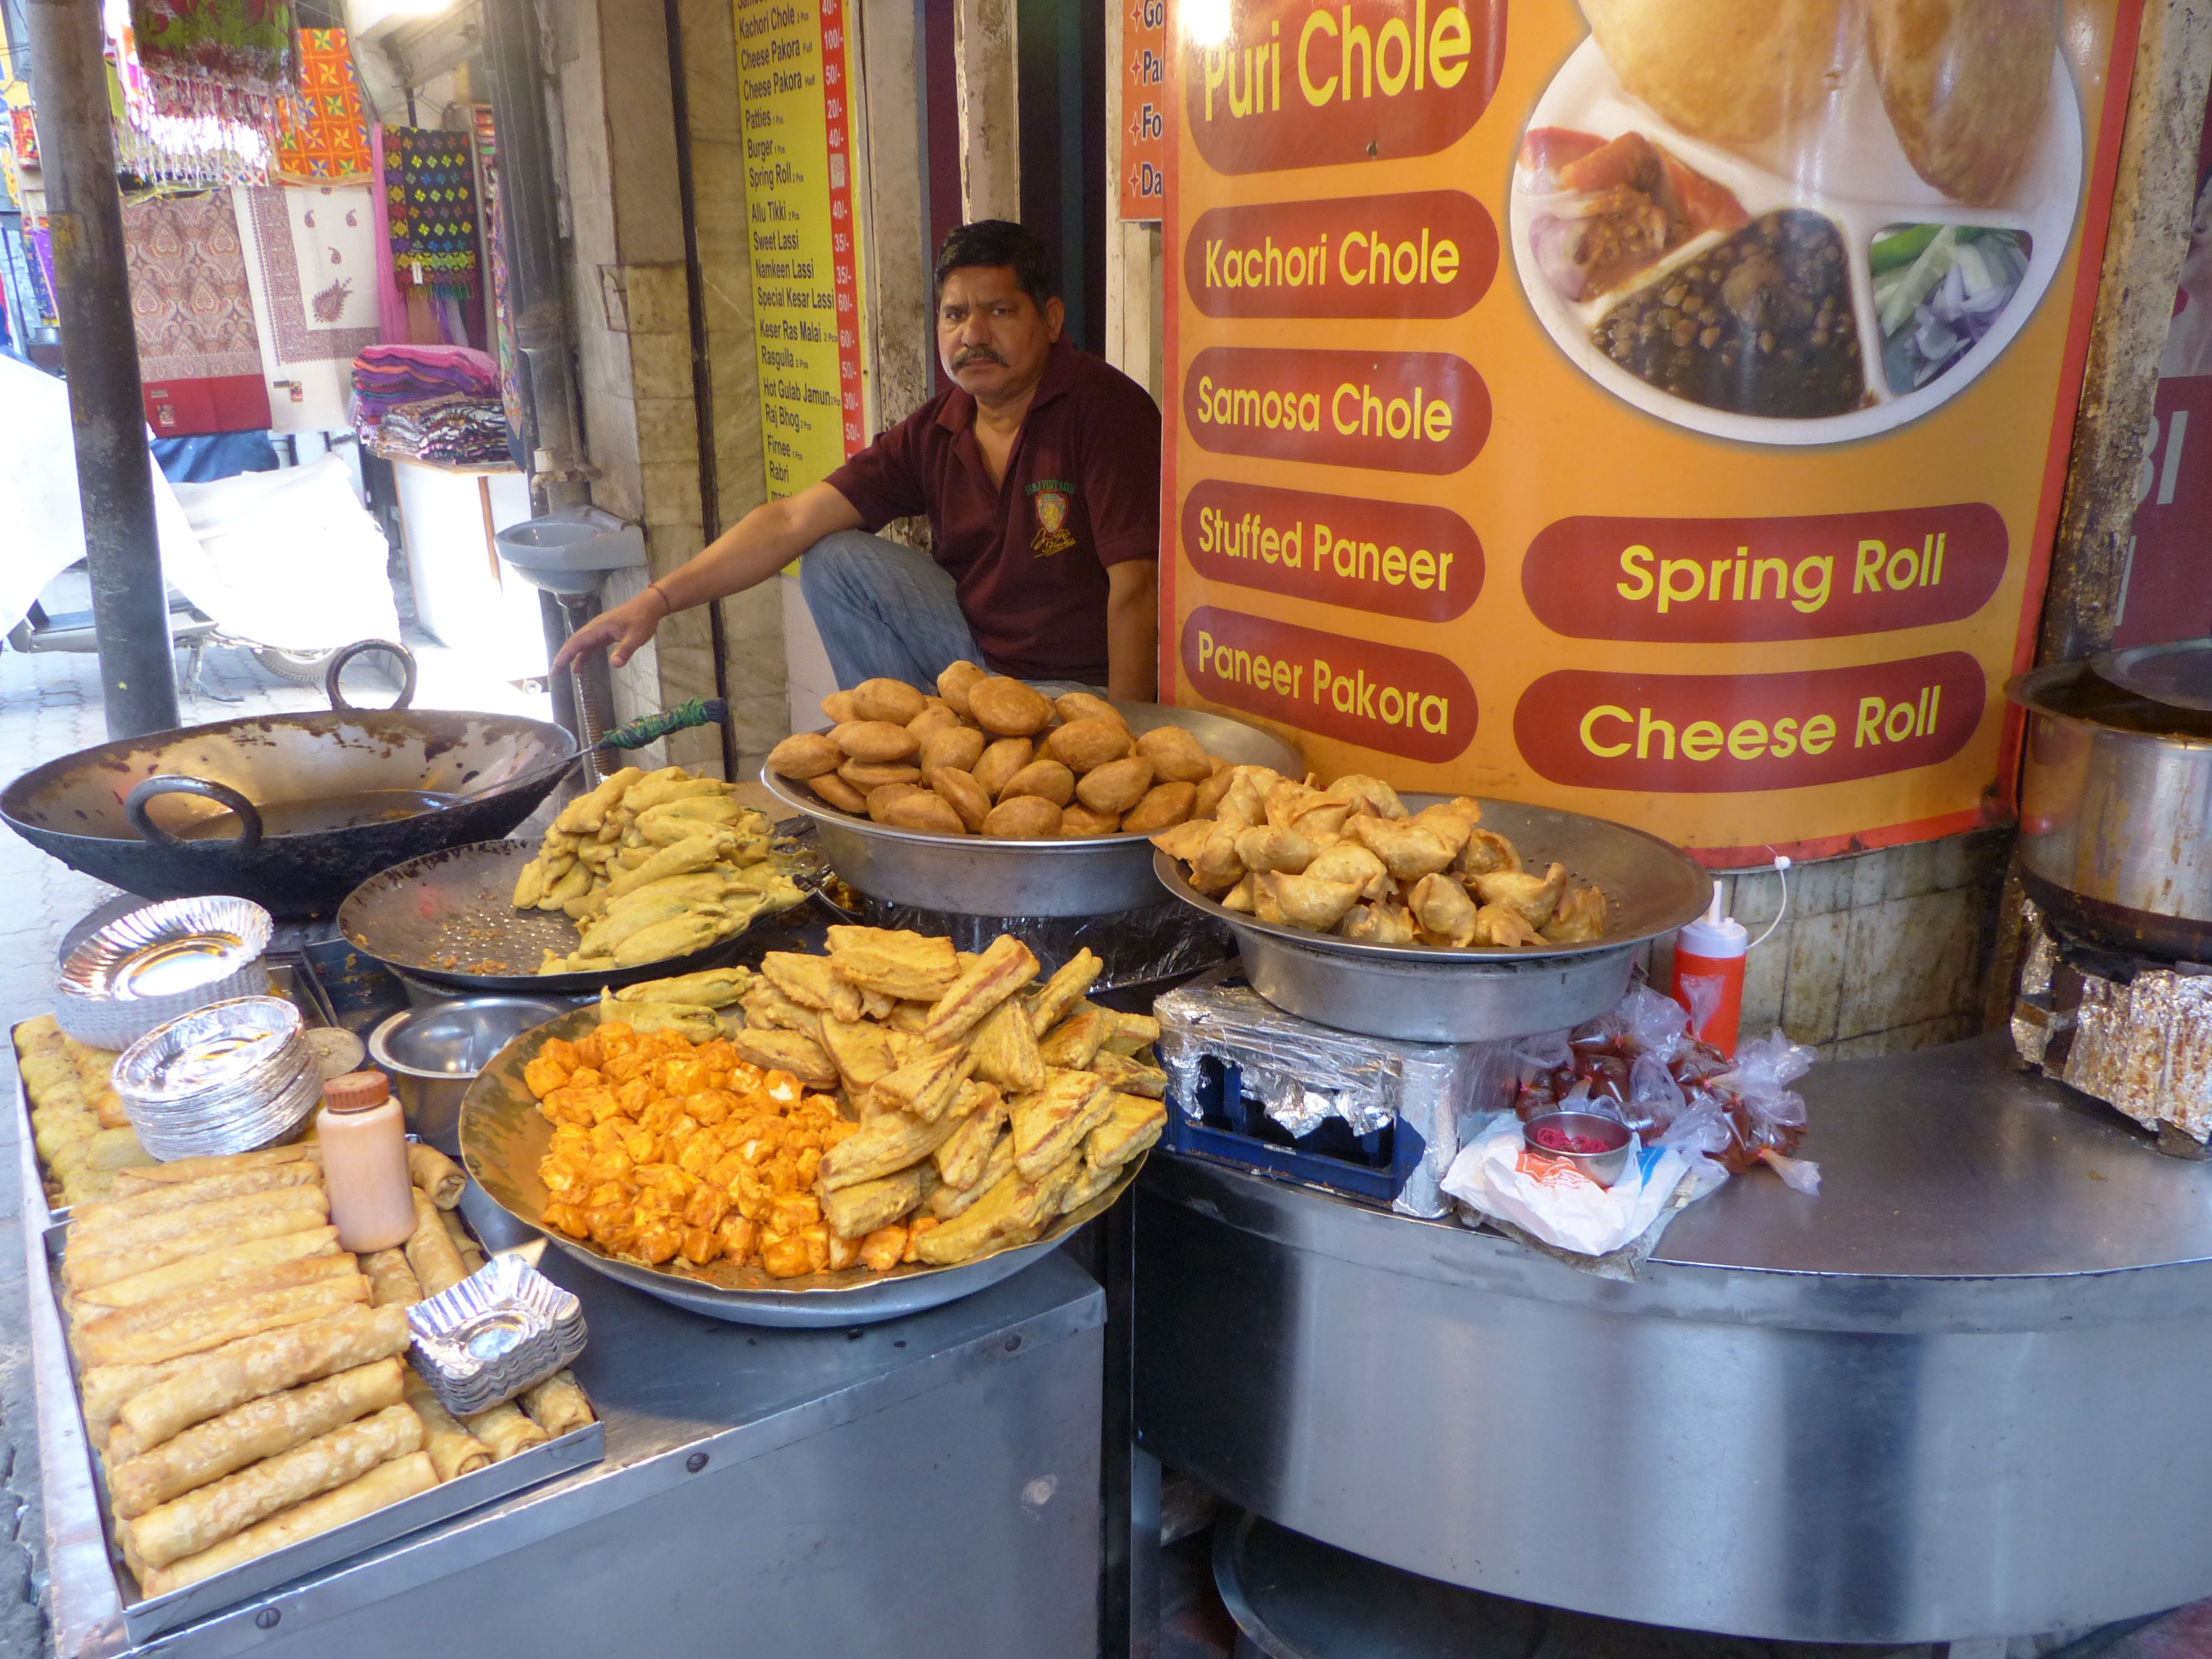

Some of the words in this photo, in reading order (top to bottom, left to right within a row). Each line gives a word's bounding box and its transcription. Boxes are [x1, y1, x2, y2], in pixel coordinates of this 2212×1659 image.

[739, 11, 769, 40] Kachori
[771, 3, 795, 30] Chole
[822, 0, 837, 15] 40/-
[742, 48, 769, 70] Cheese
[771, 38, 800, 63] Pakora
[804, 42, 812, 54] Full
[824, 28, 843, 50] 100/-
[1205, 19, 1280, 122] Puri
[1298, 0, 1471, 107] Chole
[743, 79, 771, 102] Cheese
[774, 70, 802, 95] Pakora
[805, 75, 815, 87] Half
[826, 64, 841, 85] 50/-
[1144, 51, 1162, 84] Pa
[745, 107, 771, 130] Patties
[828, 97, 842, 119] 20/-
[748, 139, 773, 162] Burger
[829, 128, 844, 148] 40/-
[749, 166, 774, 192] Spring
[775, 162, 791, 184] Roll
[752, 203, 766, 223] Allu
[768, 200, 786, 221] Tikki
[833, 200, 847, 220] 40/-
[754, 231, 776, 251] Sweet
[778, 229, 799, 250] Lassi
[834, 233, 849, 252] 35/-
[1206, 233, 1327, 288] Kachori
[1339, 227, 1459, 285] Chole
[755, 259, 790, 279] Namkeen
[792, 258, 814, 279] Lassi
[837, 266, 851, 284] 35/-
[758, 286, 785, 311] Special
[786, 287, 810, 308] Kesar
[812, 288, 834, 310] Lassi
[838, 294, 853, 312] 60/-
[759, 319, 781, 340] Keser
[782, 320, 798, 341] Ras
[800, 321, 821, 343] Malai
[841, 330, 855, 348] 60/-
[761, 346, 794, 372] Rasgulla
[842, 361, 857, 380] 50/-
[764, 377, 777, 398] Hot
[779, 379, 801, 402] Gulab
[804, 383, 830, 406] Jamun
[844, 392, 859, 410] 30/-
[1198, 375, 1320, 431] Samosa
[1332, 383, 1452, 442] Chole
[765, 404, 778, 429] Raj
[779, 406, 800, 433] Bhog
[846, 422, 860, 442] 50/-
[768, 435, 790, 458] Firnee
[770, 461, 789, 483] Rabri
[1199, 506, 1302, 568] Stuffed
[1314, 524, 1453, 591] Paneer
[1616, 545, 1834, 613] Spring
[1853, 533, 1945, 594] Roll
[1198, 630, 1302, 698] Paneer
[1313, 659, 1448, 735] Pakora
[1579, 705, 1837, 761] Cheese
[1854, 685, 1941, 748] Roll
